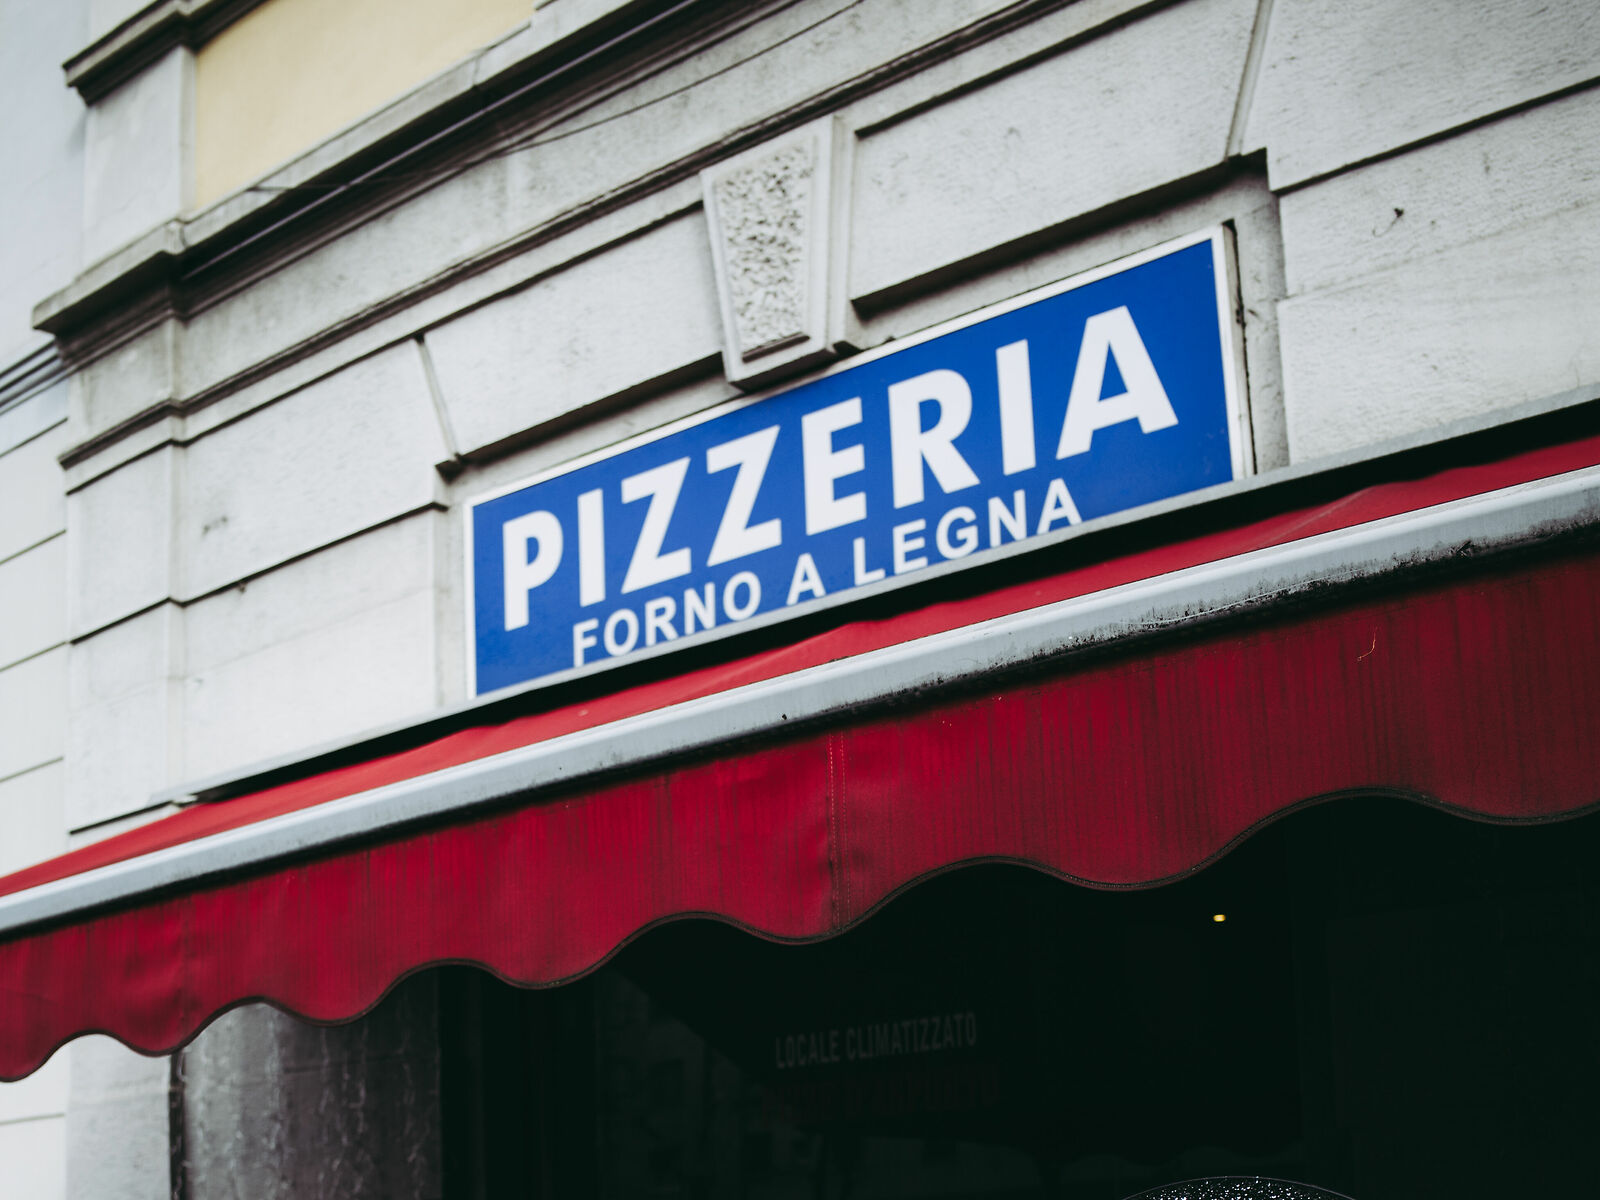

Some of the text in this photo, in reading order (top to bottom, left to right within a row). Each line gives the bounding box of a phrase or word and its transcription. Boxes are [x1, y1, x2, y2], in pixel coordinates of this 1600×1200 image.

[503, 305, 1179, 631] PIZZERIA
[572, 478, 1083, 668] FORNO A LEGNA
[775, 1011, 977, 1069] LOCALE CLIMATIZZATO
